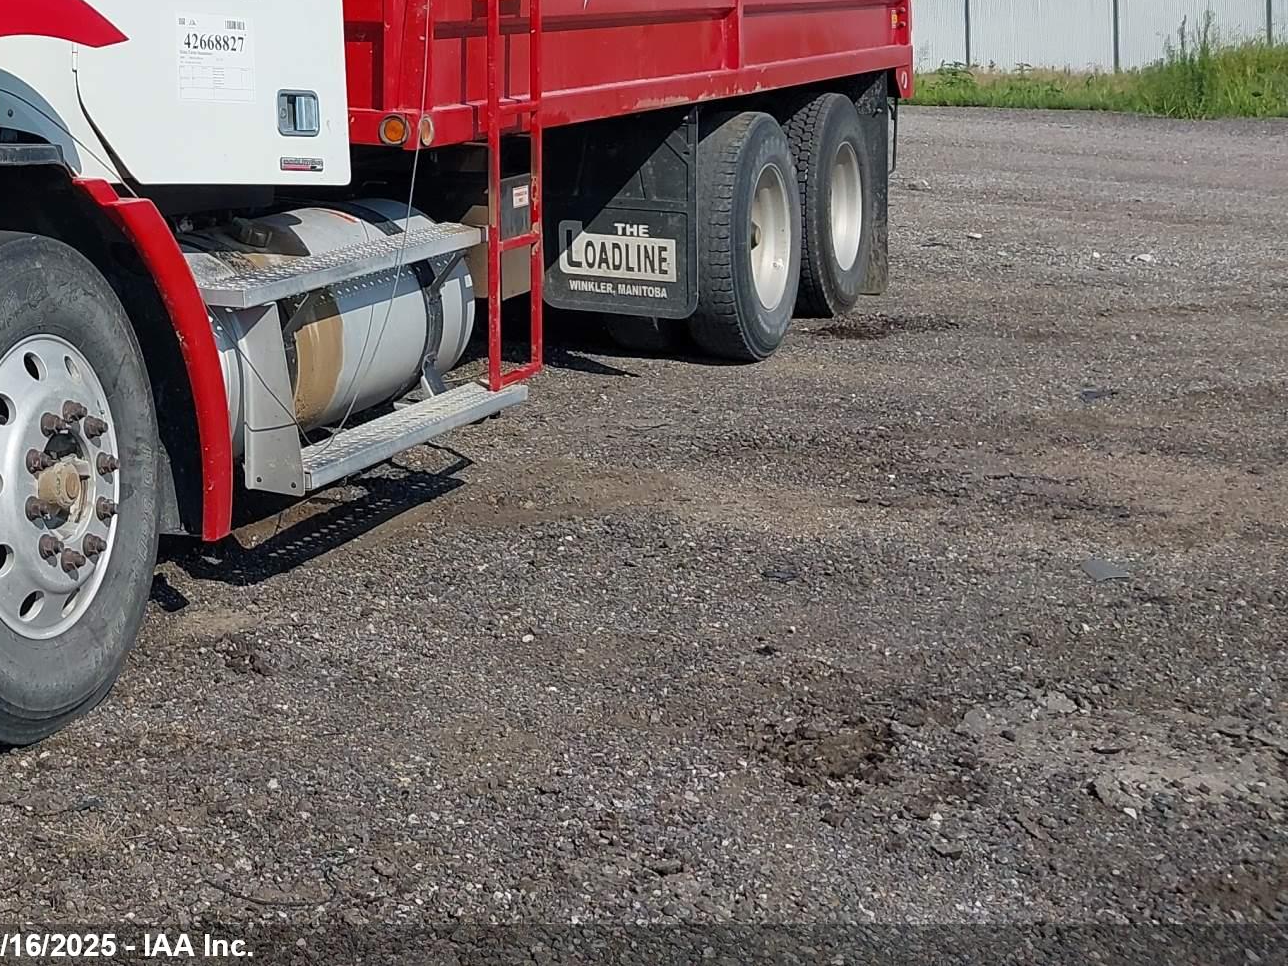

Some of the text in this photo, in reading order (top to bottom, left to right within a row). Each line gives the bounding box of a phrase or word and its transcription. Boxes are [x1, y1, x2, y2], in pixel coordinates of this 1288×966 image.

[184, 33, 244, 52] 42668827
[614, 223, 649, 237] THE
[566, 229, 668, 275] LOADLINE
[569, 279, 668, 298] WINKLER, MANITOBA
